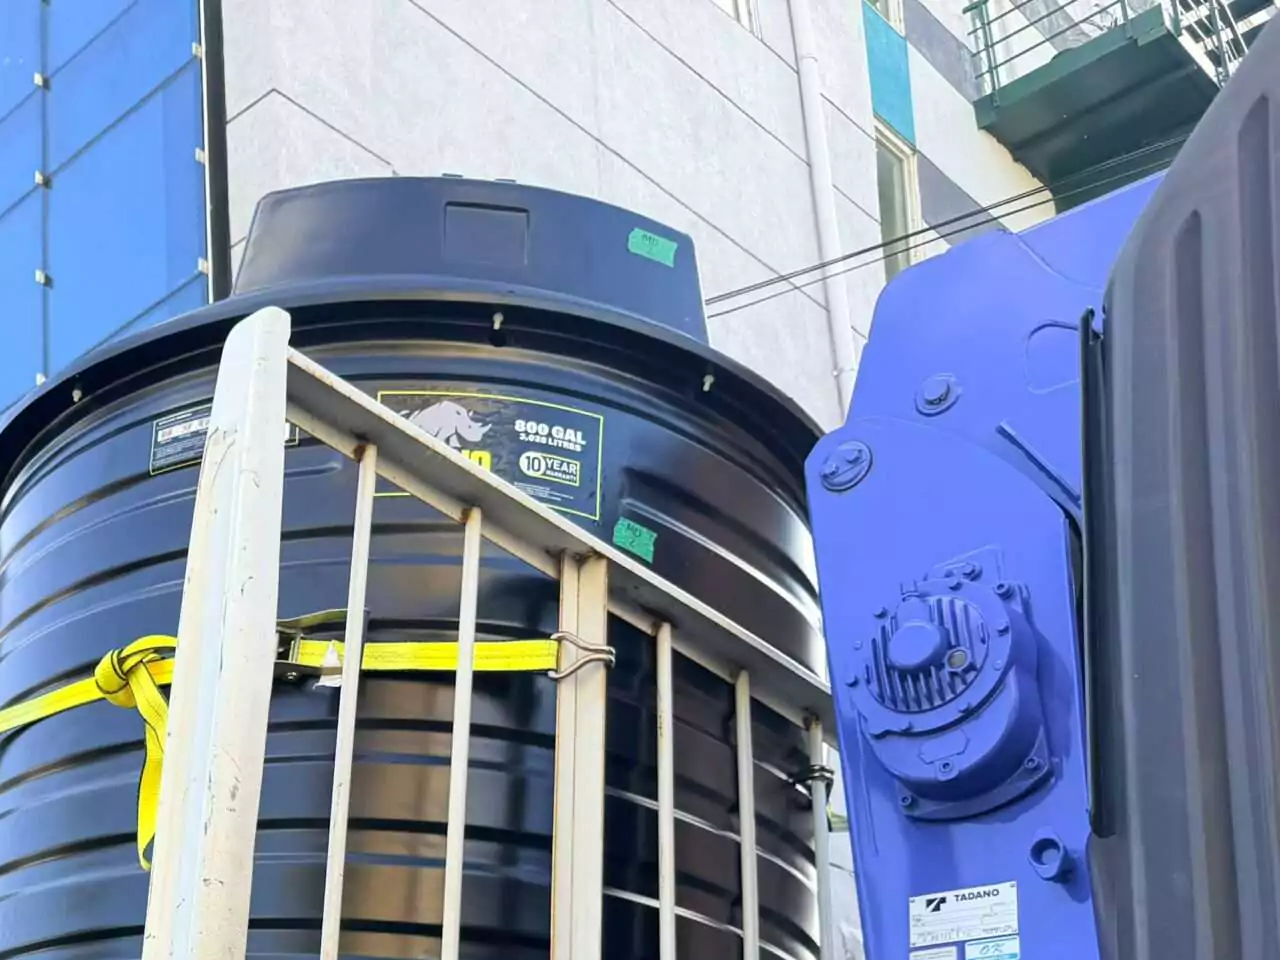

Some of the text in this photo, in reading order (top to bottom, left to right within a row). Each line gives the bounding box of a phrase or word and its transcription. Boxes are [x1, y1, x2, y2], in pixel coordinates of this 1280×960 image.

[514, 418, 587, 445] 800 GAL
[548, 437, 582, 453] LITRES
[525, 455, 577, 475] 10 YEAR
[953, 888, 1000, 902] TADANO
